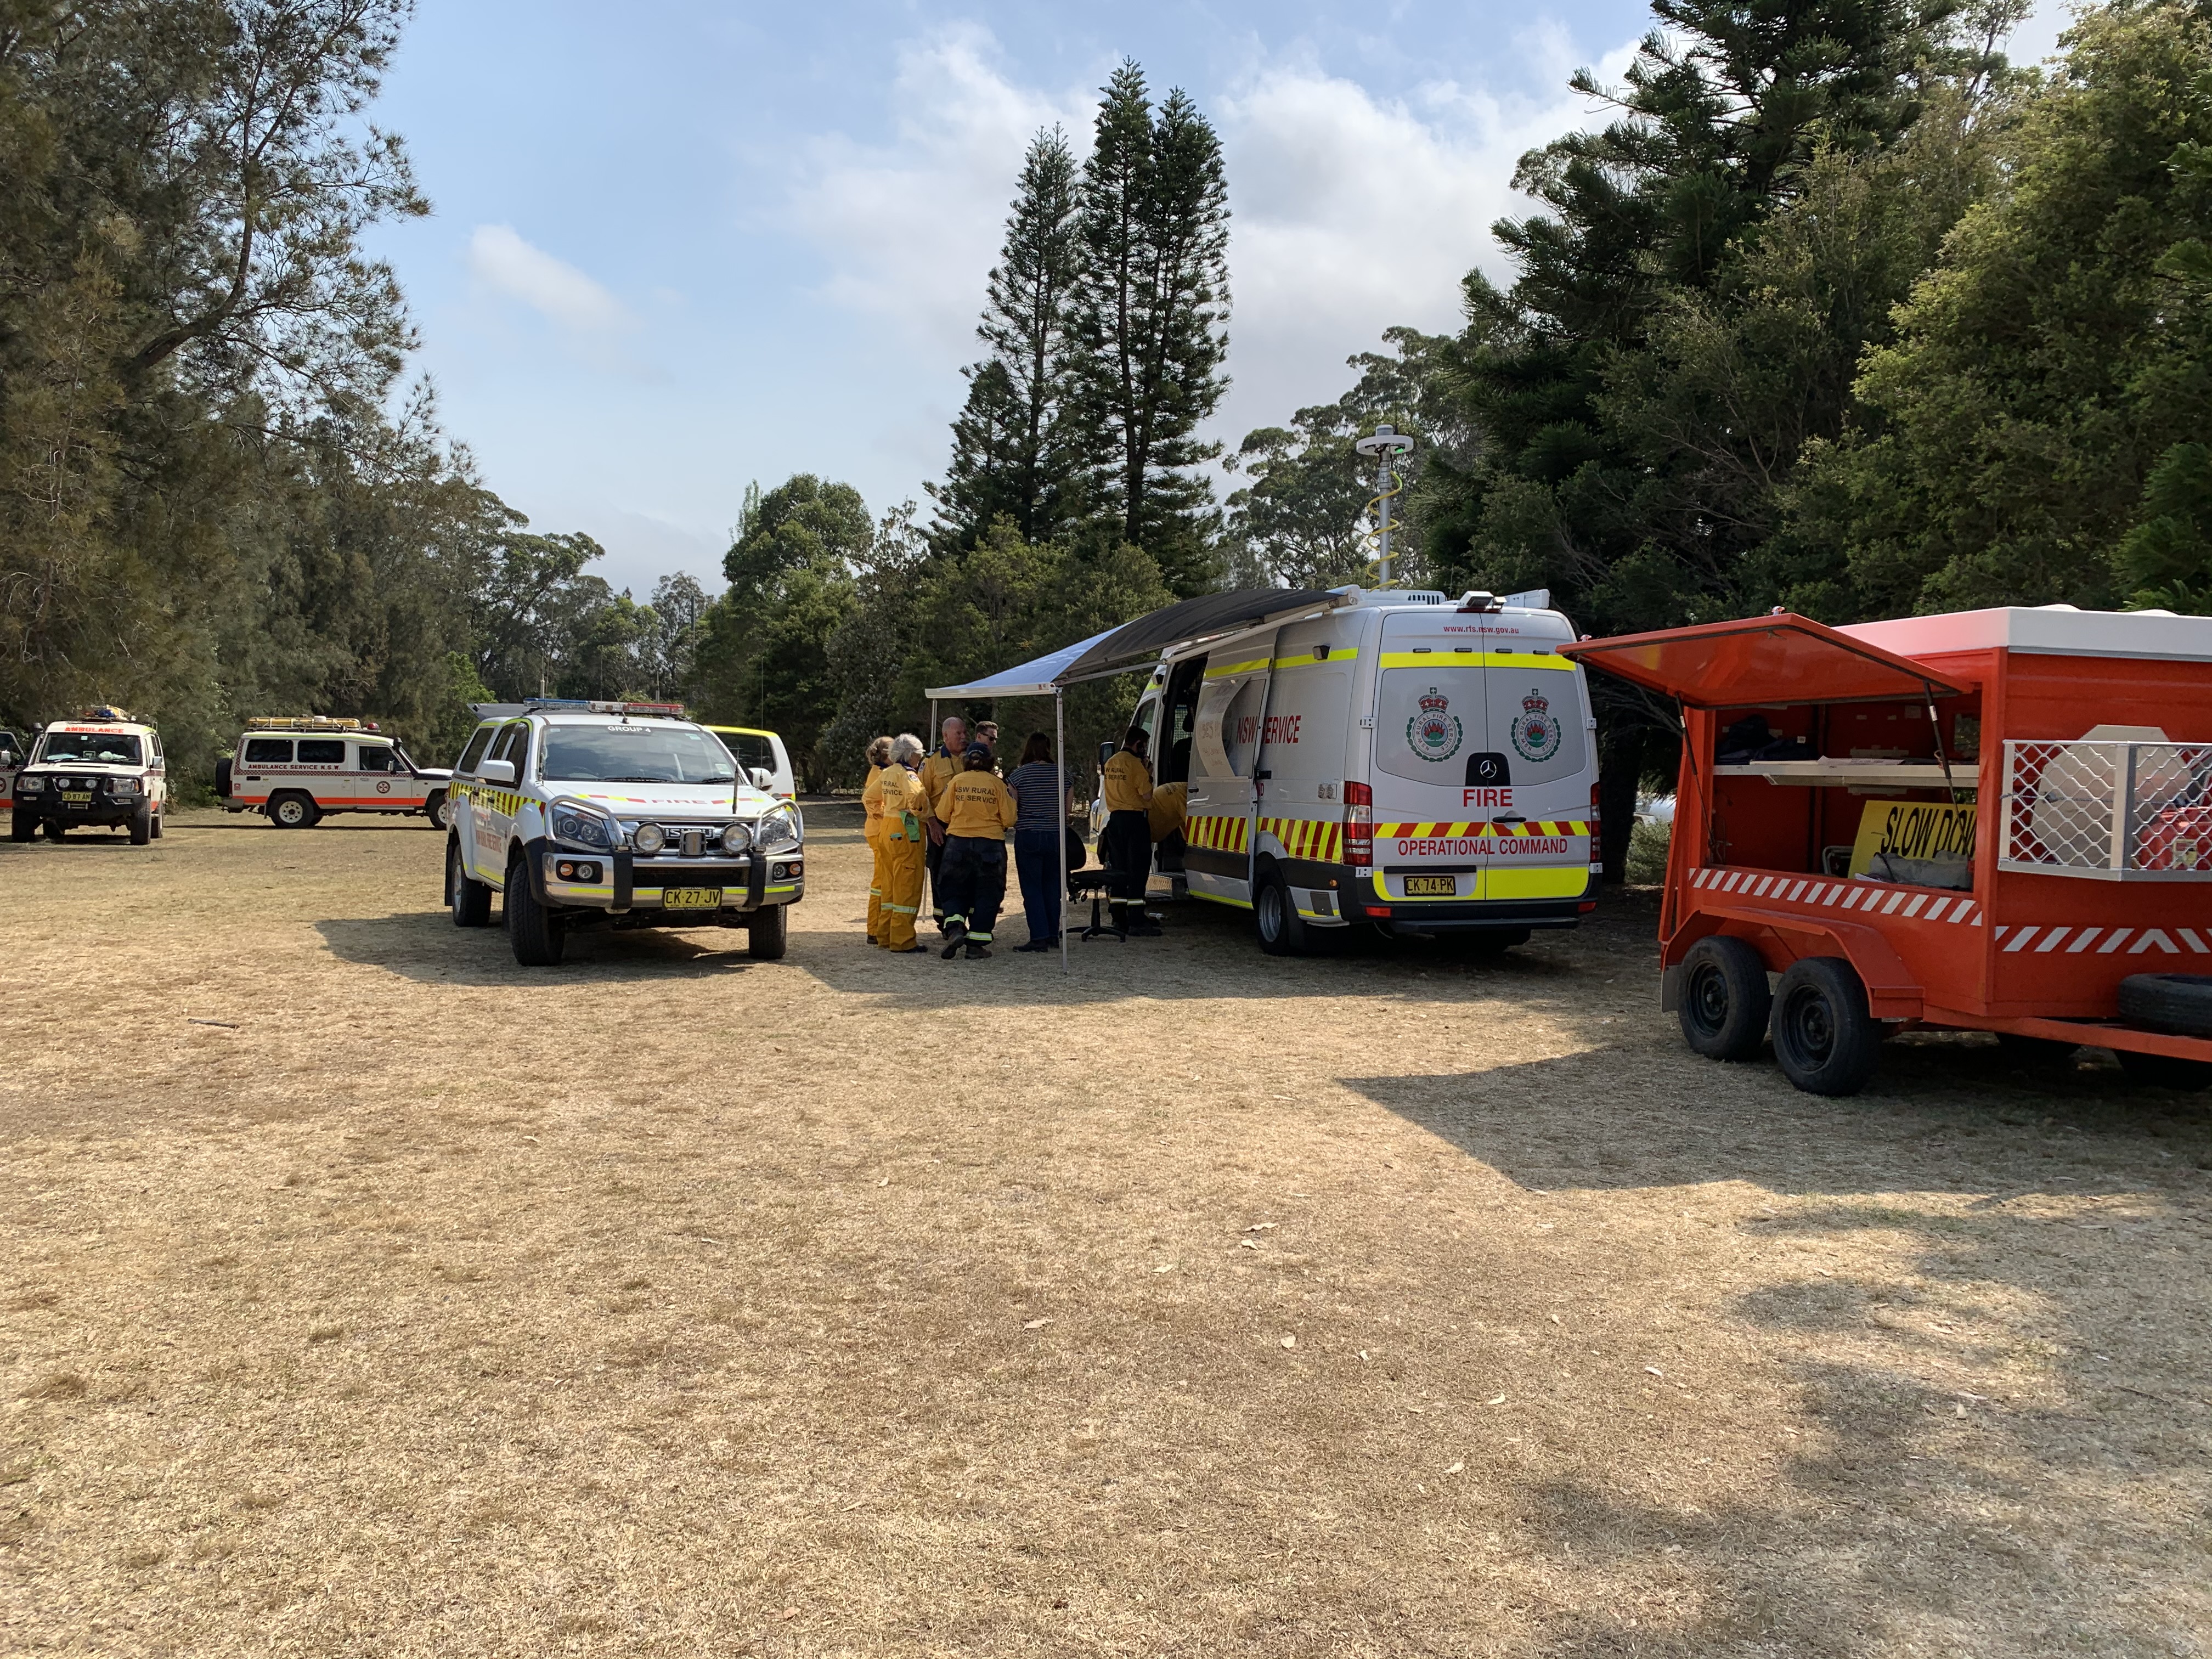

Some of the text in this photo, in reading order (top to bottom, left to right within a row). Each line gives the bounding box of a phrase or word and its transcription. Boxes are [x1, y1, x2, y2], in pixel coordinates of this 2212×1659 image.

[1443, 625, 1519, 634] www.rfs.nsw.gov.au
[1237, 715, 1258, 744] NSW
[1416, 713, 1453, 751] NSW RURAL FIRE SERVICE
[1520, 715, 1532, 735] RURAL
[1534, 714, 1548, 723] FIRE
[1542, 724, 1553, 752] SERVICE
[967, 795, 997, 804] SERVICE
[972, 787, 996, 796] RURAL
[1463, 789, 1513, 807] FIRE
[1881, 806, 1939, 858] SLOW
[1398, 838, 1568, 856] OPERATIONAL COMMAND
